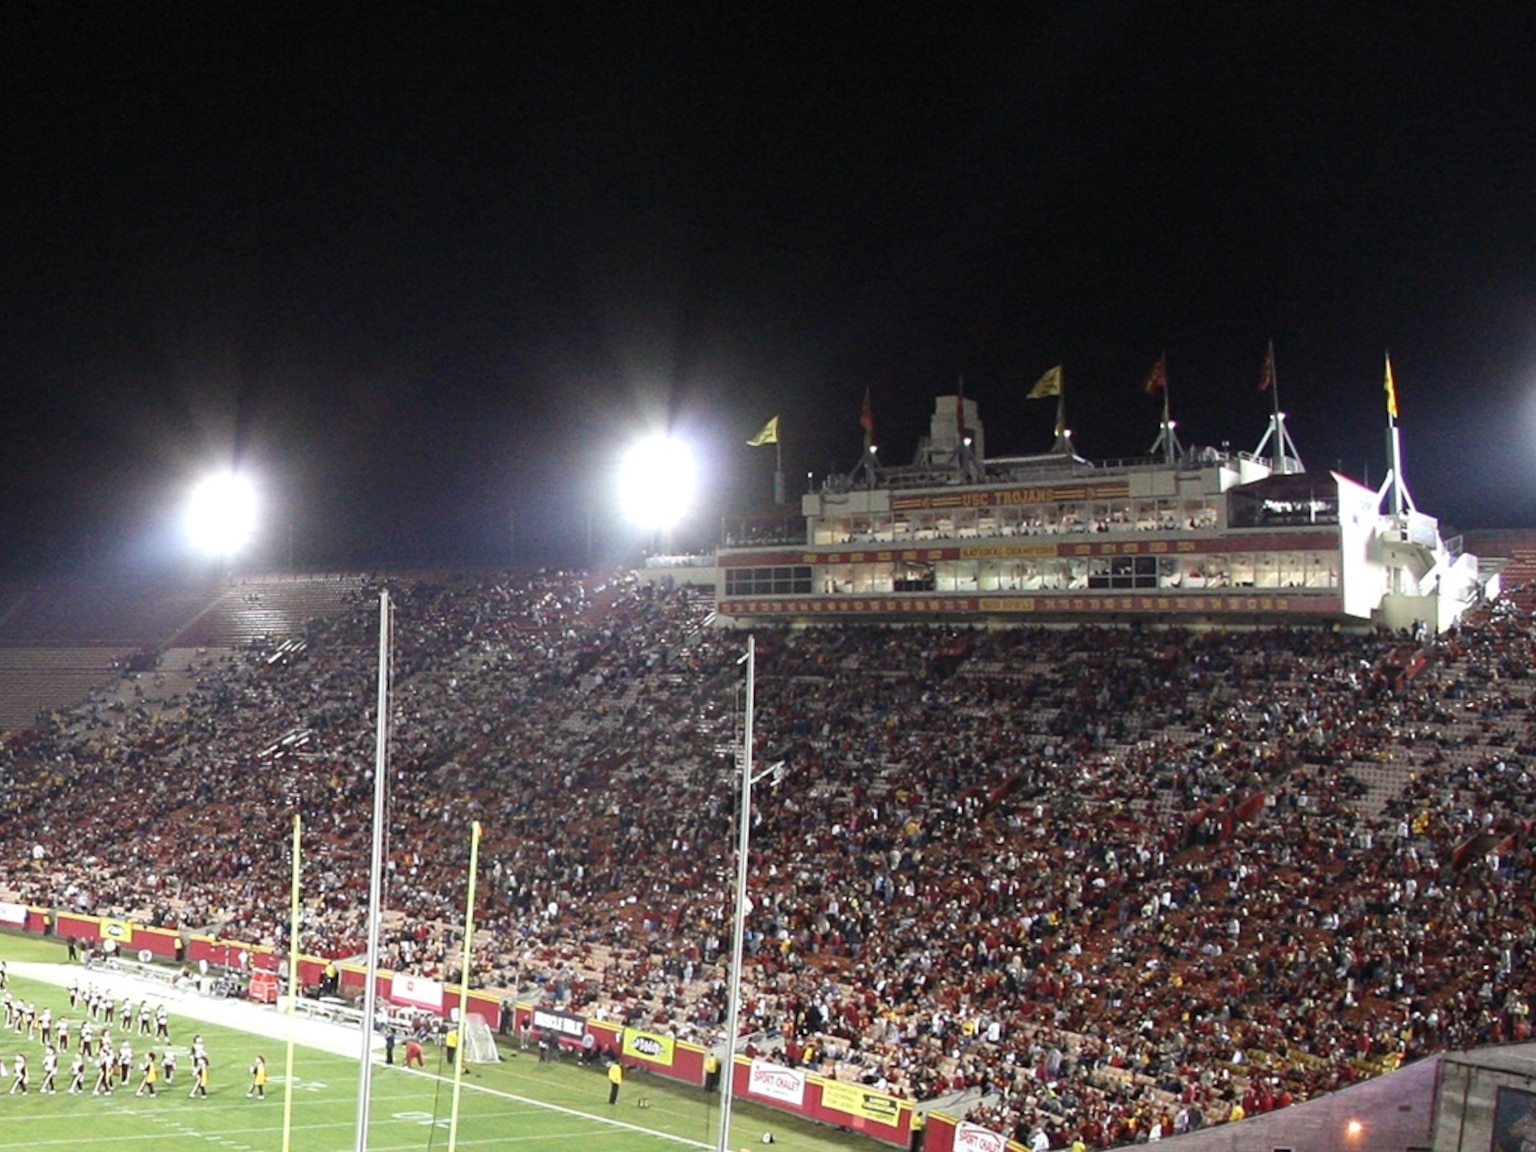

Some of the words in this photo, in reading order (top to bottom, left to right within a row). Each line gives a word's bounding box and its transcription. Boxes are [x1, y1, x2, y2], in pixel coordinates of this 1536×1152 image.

[962, 494, 989, 506] USC
[995, 488, 1055, 504] TROJANS
[754, 1068, 774, 1089] SPORT
[775, 1073, 801, 1093] CHALET
[958, 1127, 979, 1149] SPORT
